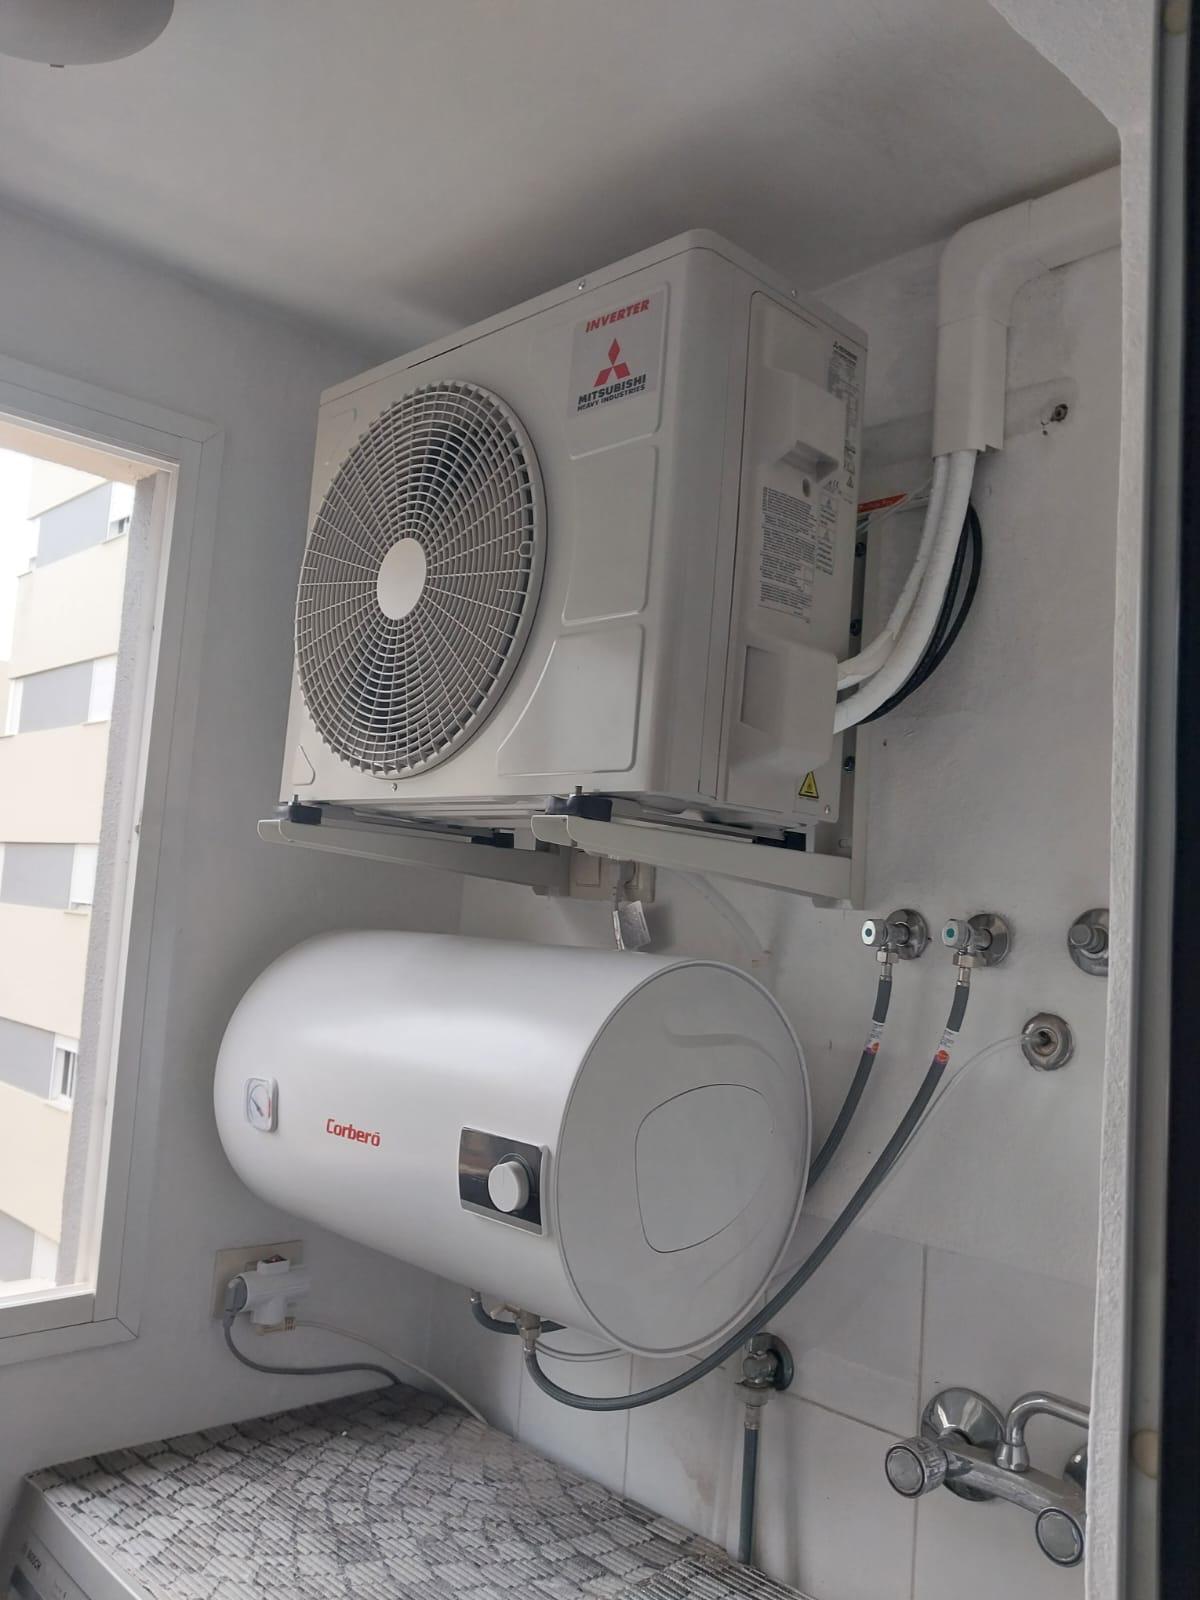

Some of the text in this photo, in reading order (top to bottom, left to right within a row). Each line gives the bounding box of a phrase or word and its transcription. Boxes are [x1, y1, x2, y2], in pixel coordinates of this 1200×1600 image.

[585, 299, 650, 333] INVERTER
[577, 384, 646, 412] HEAVY INDUSTRIES
[578, 374, 647, 405] MITSUBISHI
